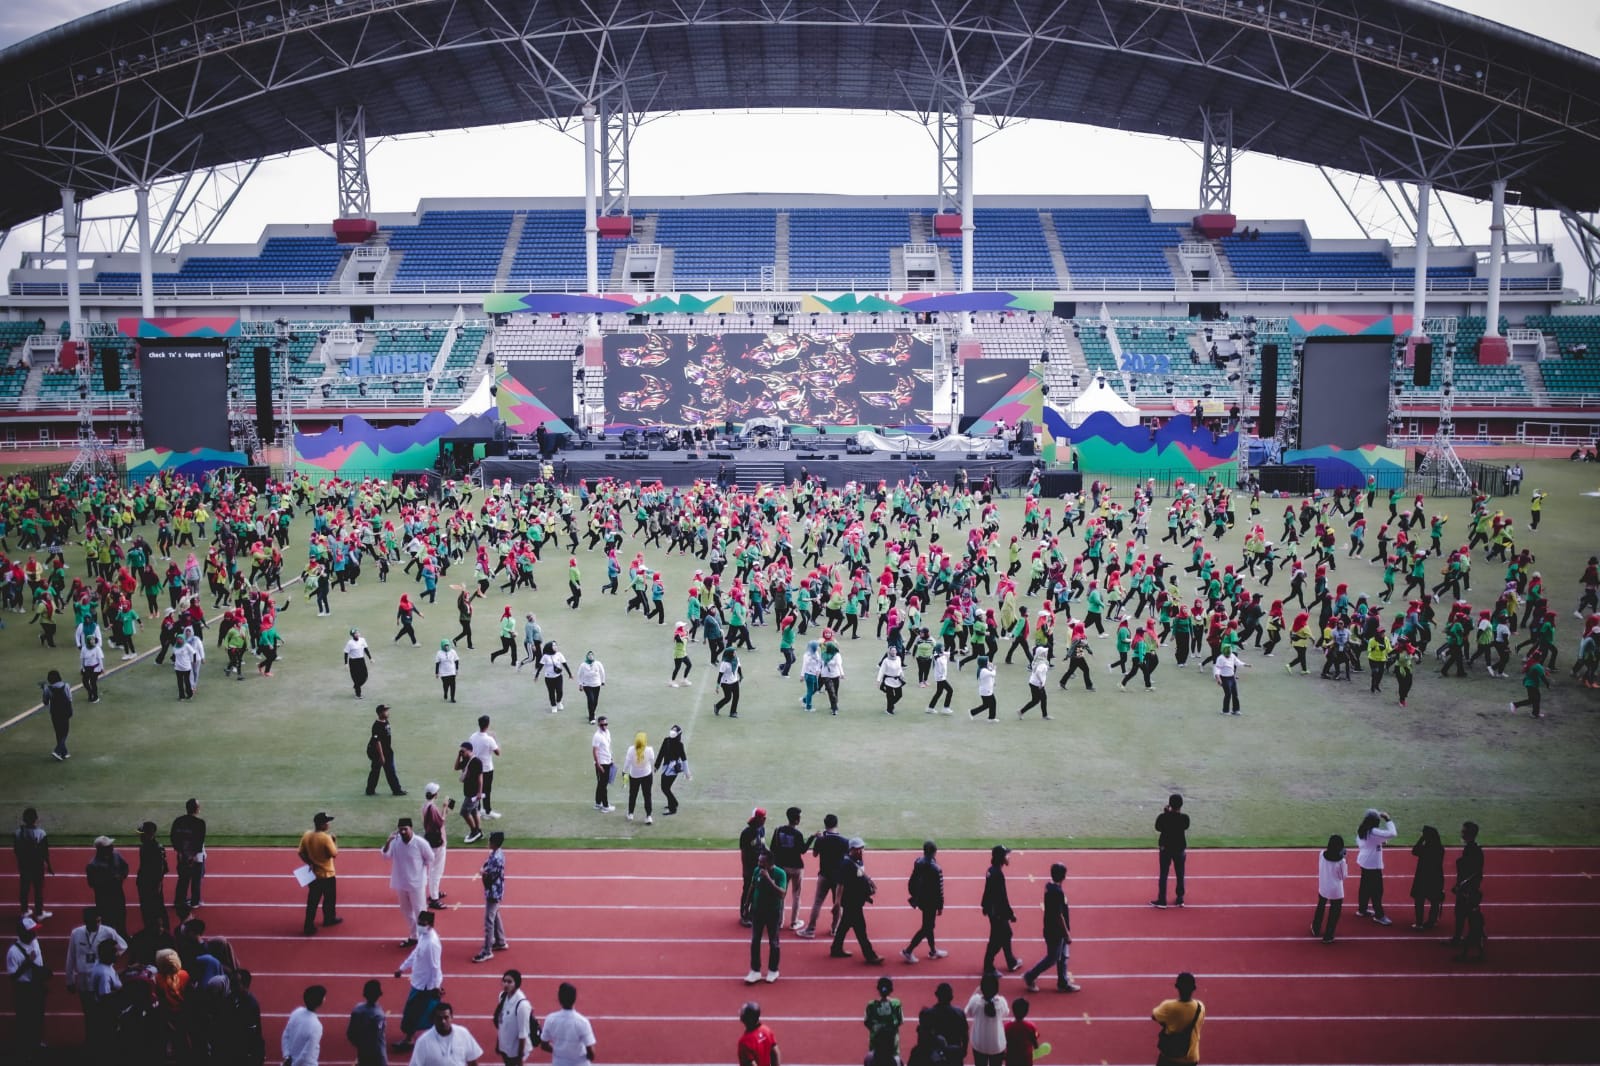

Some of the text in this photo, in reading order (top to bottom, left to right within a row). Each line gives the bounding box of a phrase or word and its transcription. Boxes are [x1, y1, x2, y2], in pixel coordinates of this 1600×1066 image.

[184, 351, 201, 359] input
[203, 351, 224, 359] signal
[343, 352, 432, 377] JEMBER
[1120, 352, 1169, 374] 2022
